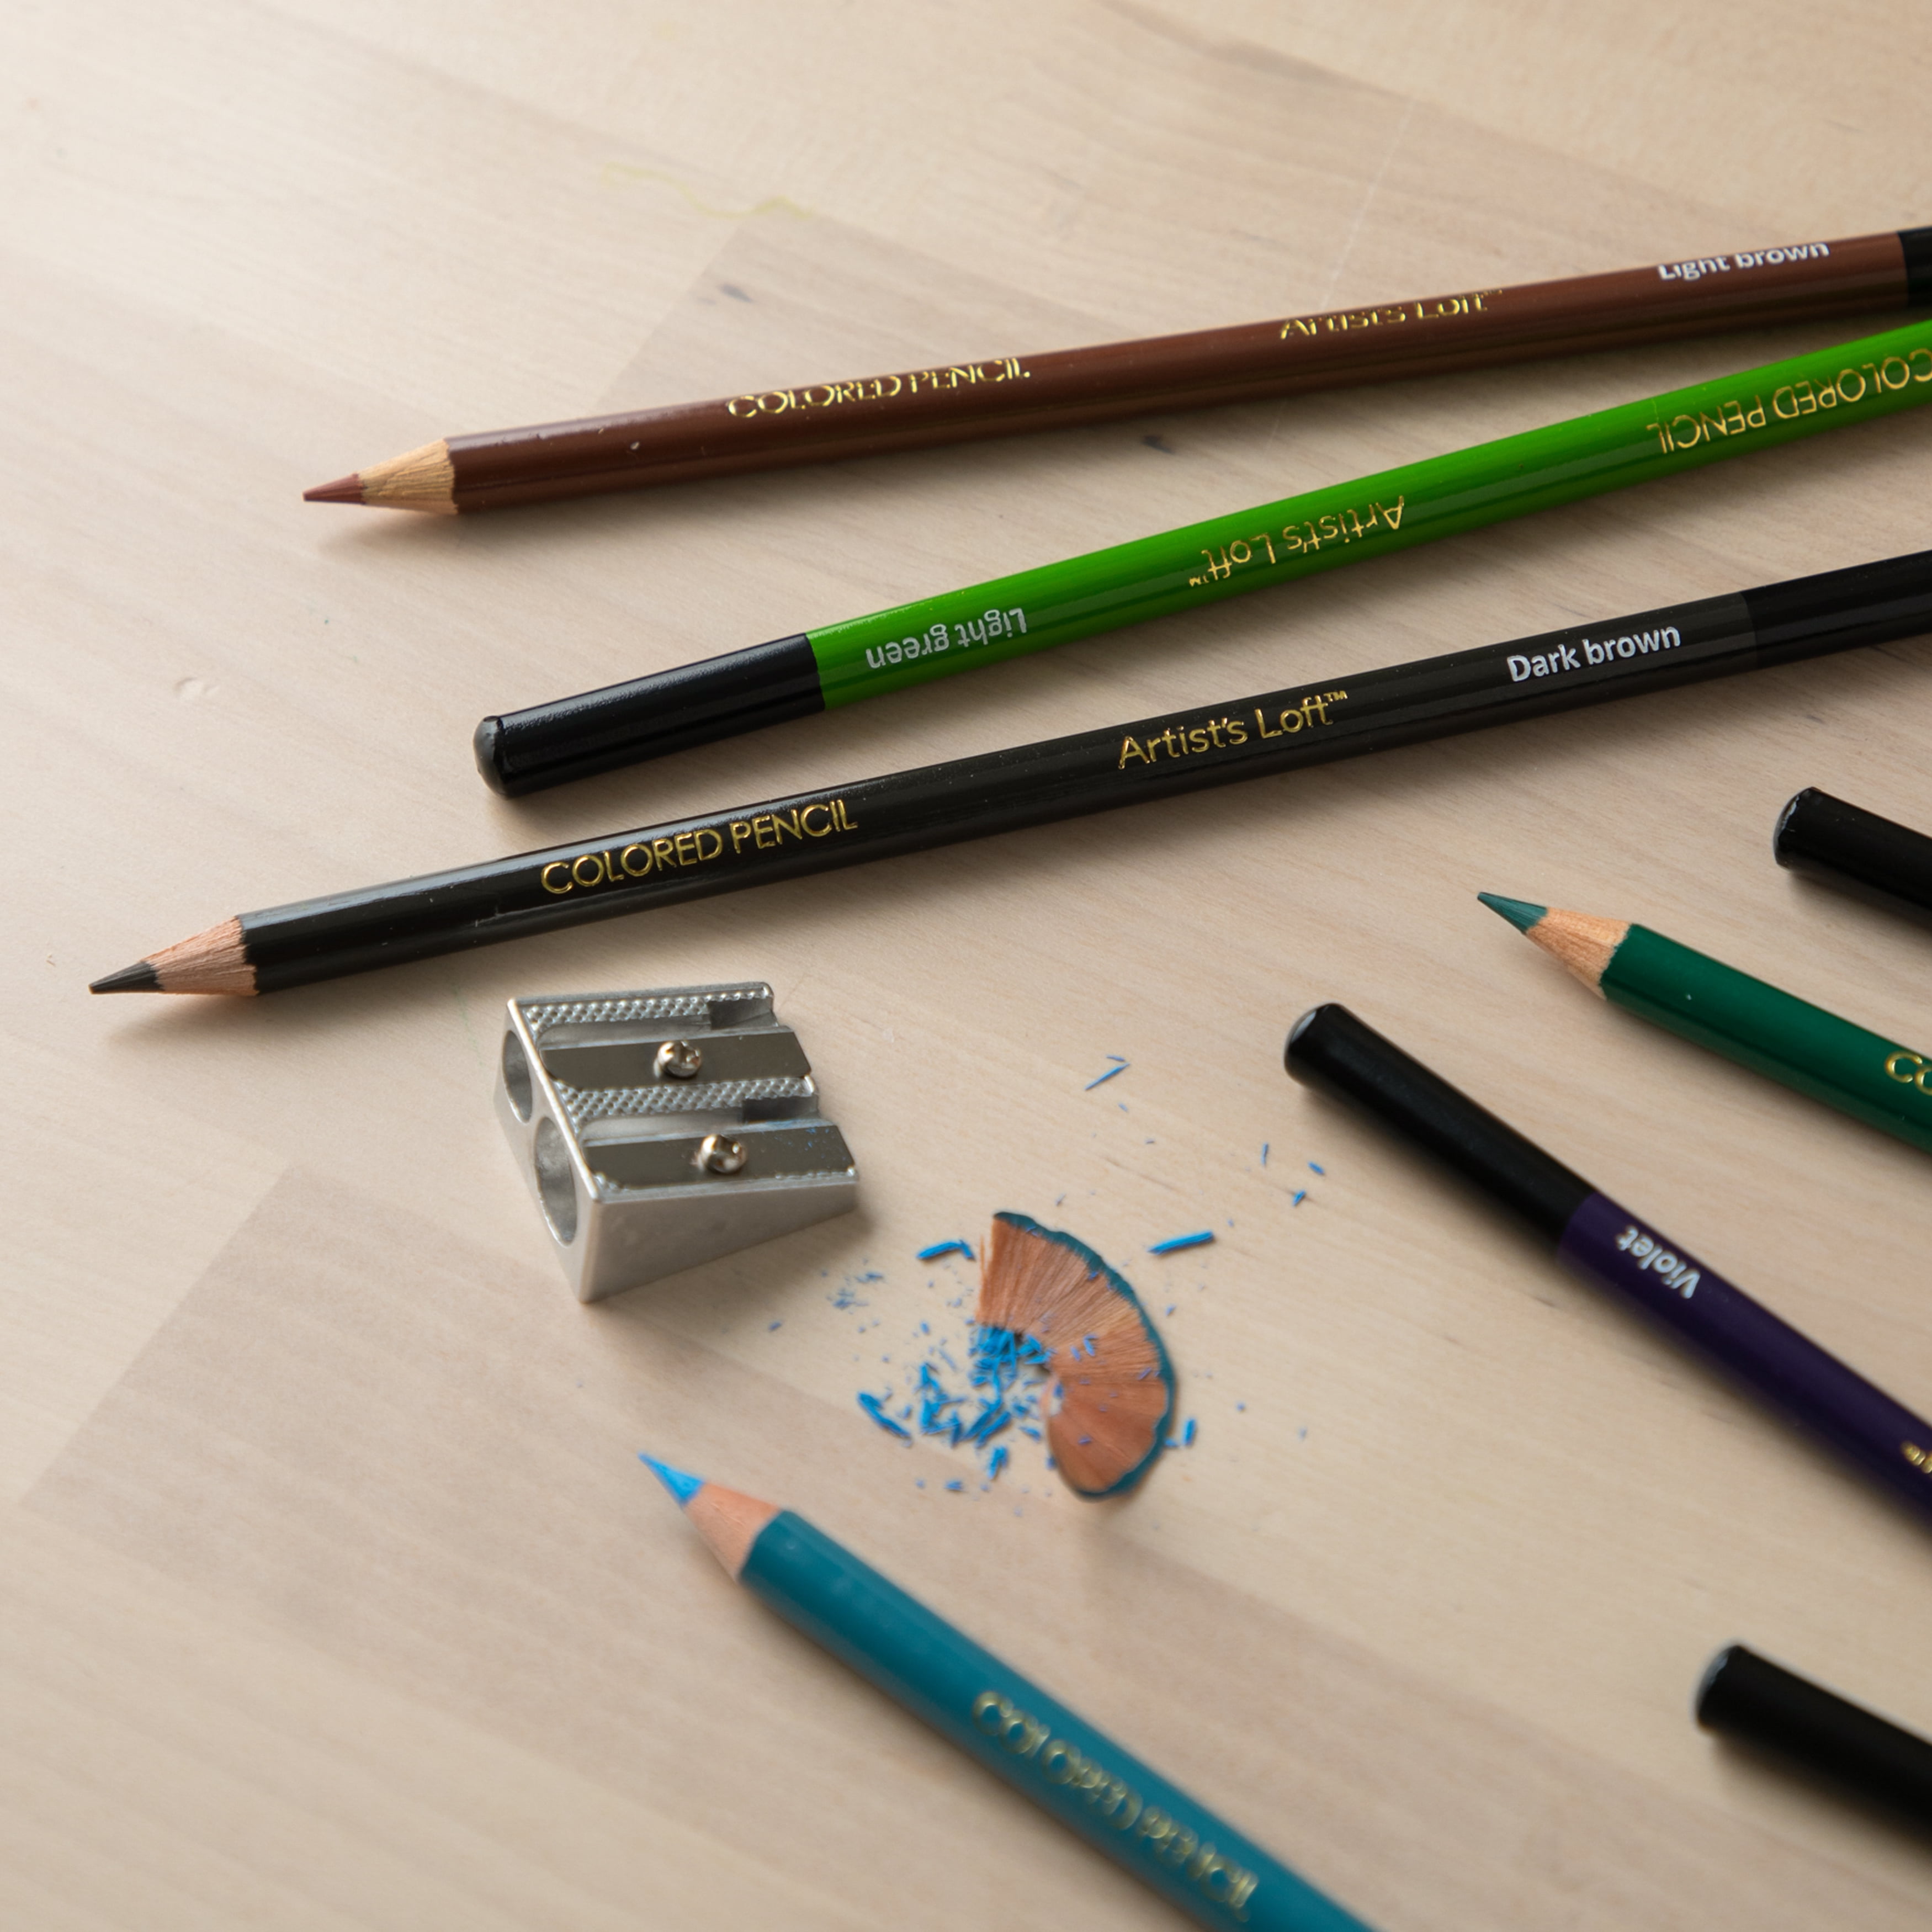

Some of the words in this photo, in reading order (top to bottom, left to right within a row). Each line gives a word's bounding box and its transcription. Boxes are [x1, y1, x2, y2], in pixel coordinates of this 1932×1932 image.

[1658, 257, 1730, 281] Light
[1734, 242, 1830, 269] brown
[727, 375, 901, 418] COLORED
[1772, 348, 1932, 419] COLORED
[1646, 395, 1766, 454] PENCIL
[1282, 495, 1405, 553] Artist's
[865, 624, 949, 669] green
[954, 607, 1027, 645] Light
[1506, 644, 1581, 682] Dark
[1581, 626, 1681, 665] brown
[1117, 717, 1249, 770] Artist's
[540, 828, 723, 895] COLORED
[728, 798, 858, 854] PENCIL
[1615, 1225, 1701, 1299] Violet
